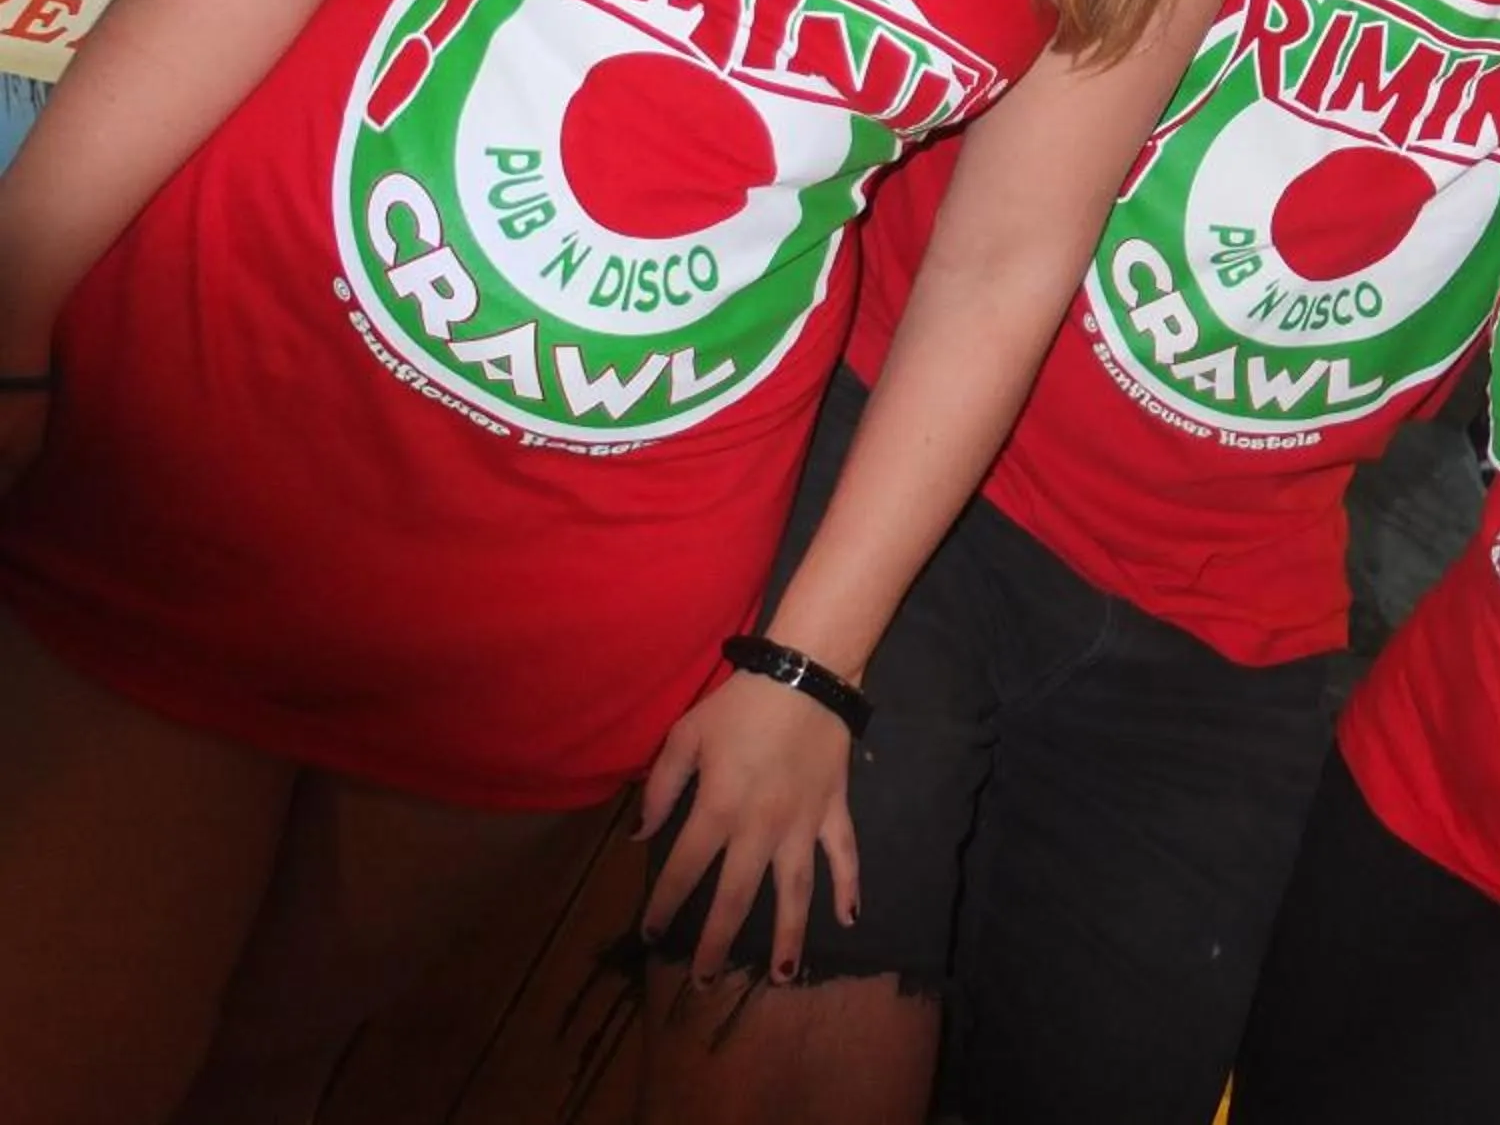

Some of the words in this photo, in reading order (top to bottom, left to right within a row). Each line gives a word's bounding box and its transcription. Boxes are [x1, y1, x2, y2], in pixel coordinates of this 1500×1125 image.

[366, 171, 738, 421] CRAWL
[485, 147, 556, 240] PUB
[588, 244, 719, 313] DISCO
[1209, 224, 1263, 288] PUB
[1278, 280, 1382, 332] DISCO
[1112, 237, 1384, 413] CRAWL
